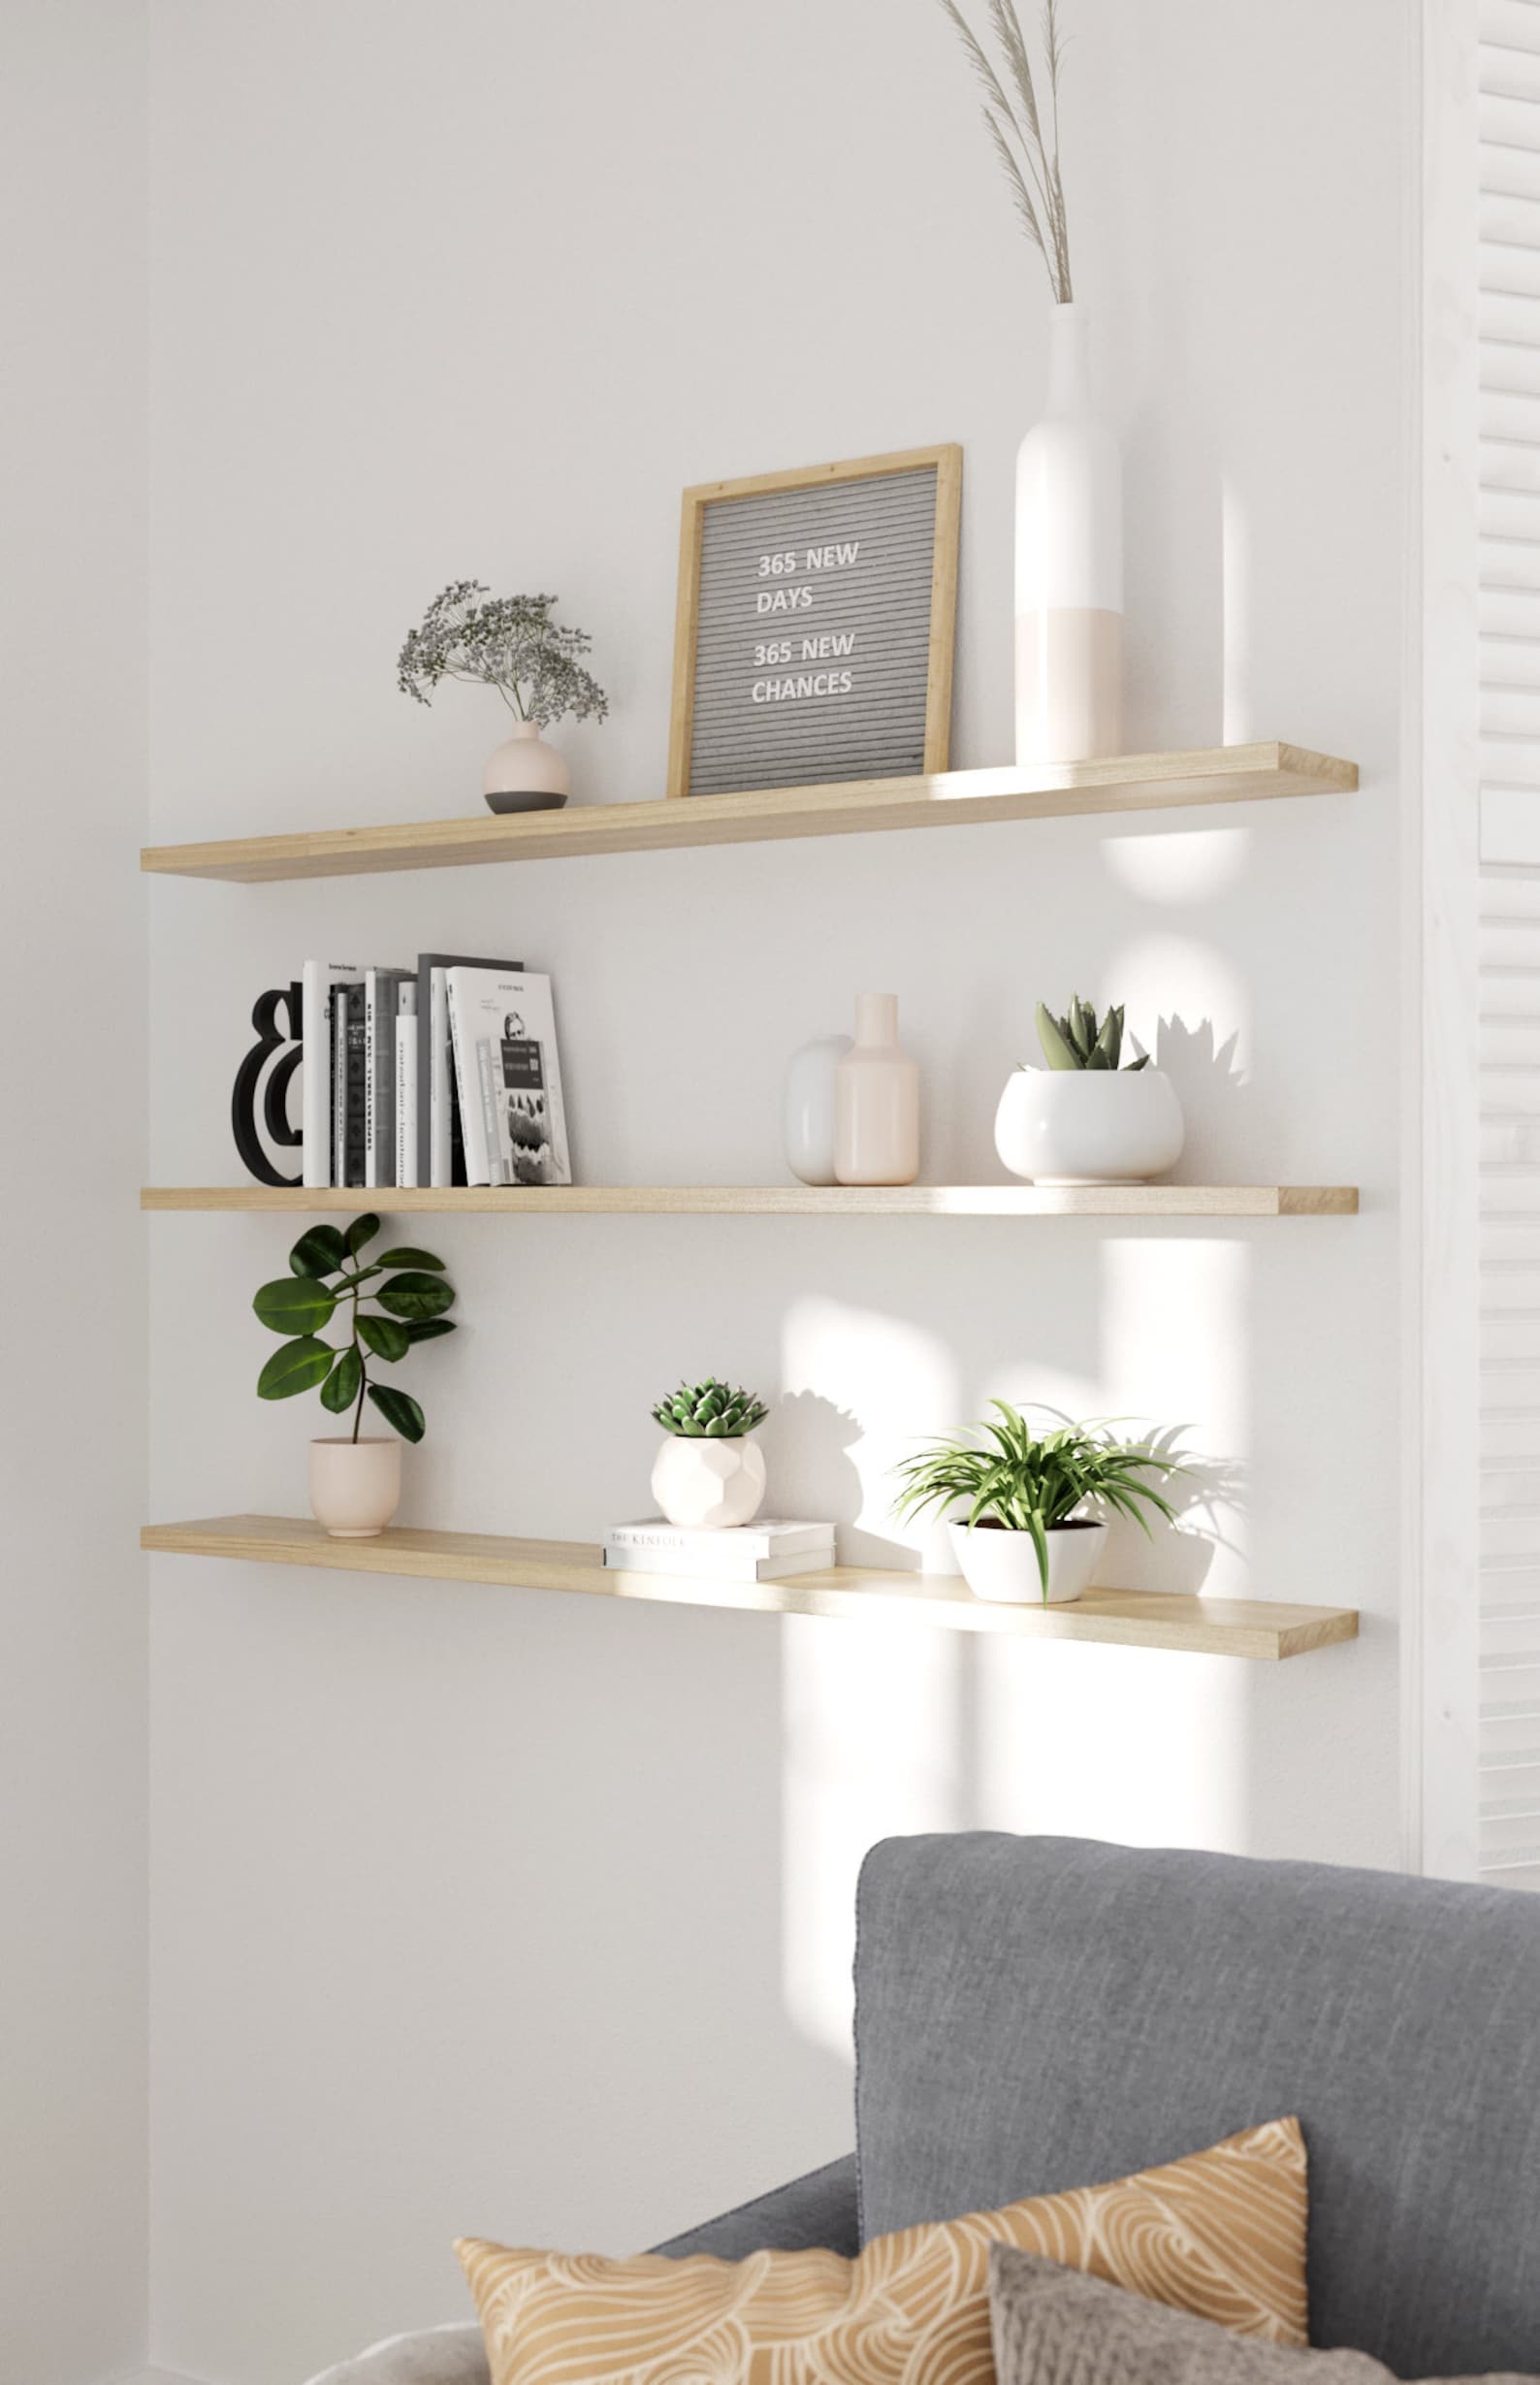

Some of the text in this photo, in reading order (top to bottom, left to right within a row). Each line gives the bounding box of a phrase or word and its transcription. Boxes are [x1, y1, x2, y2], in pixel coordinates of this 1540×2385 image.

[757, 541, 859, 576] 365 NEW
[756, 585, 814, 613] DAYS
[753, 632, 855, 666] 365 NEW
[752, 671, 853, 702] CHANCES
